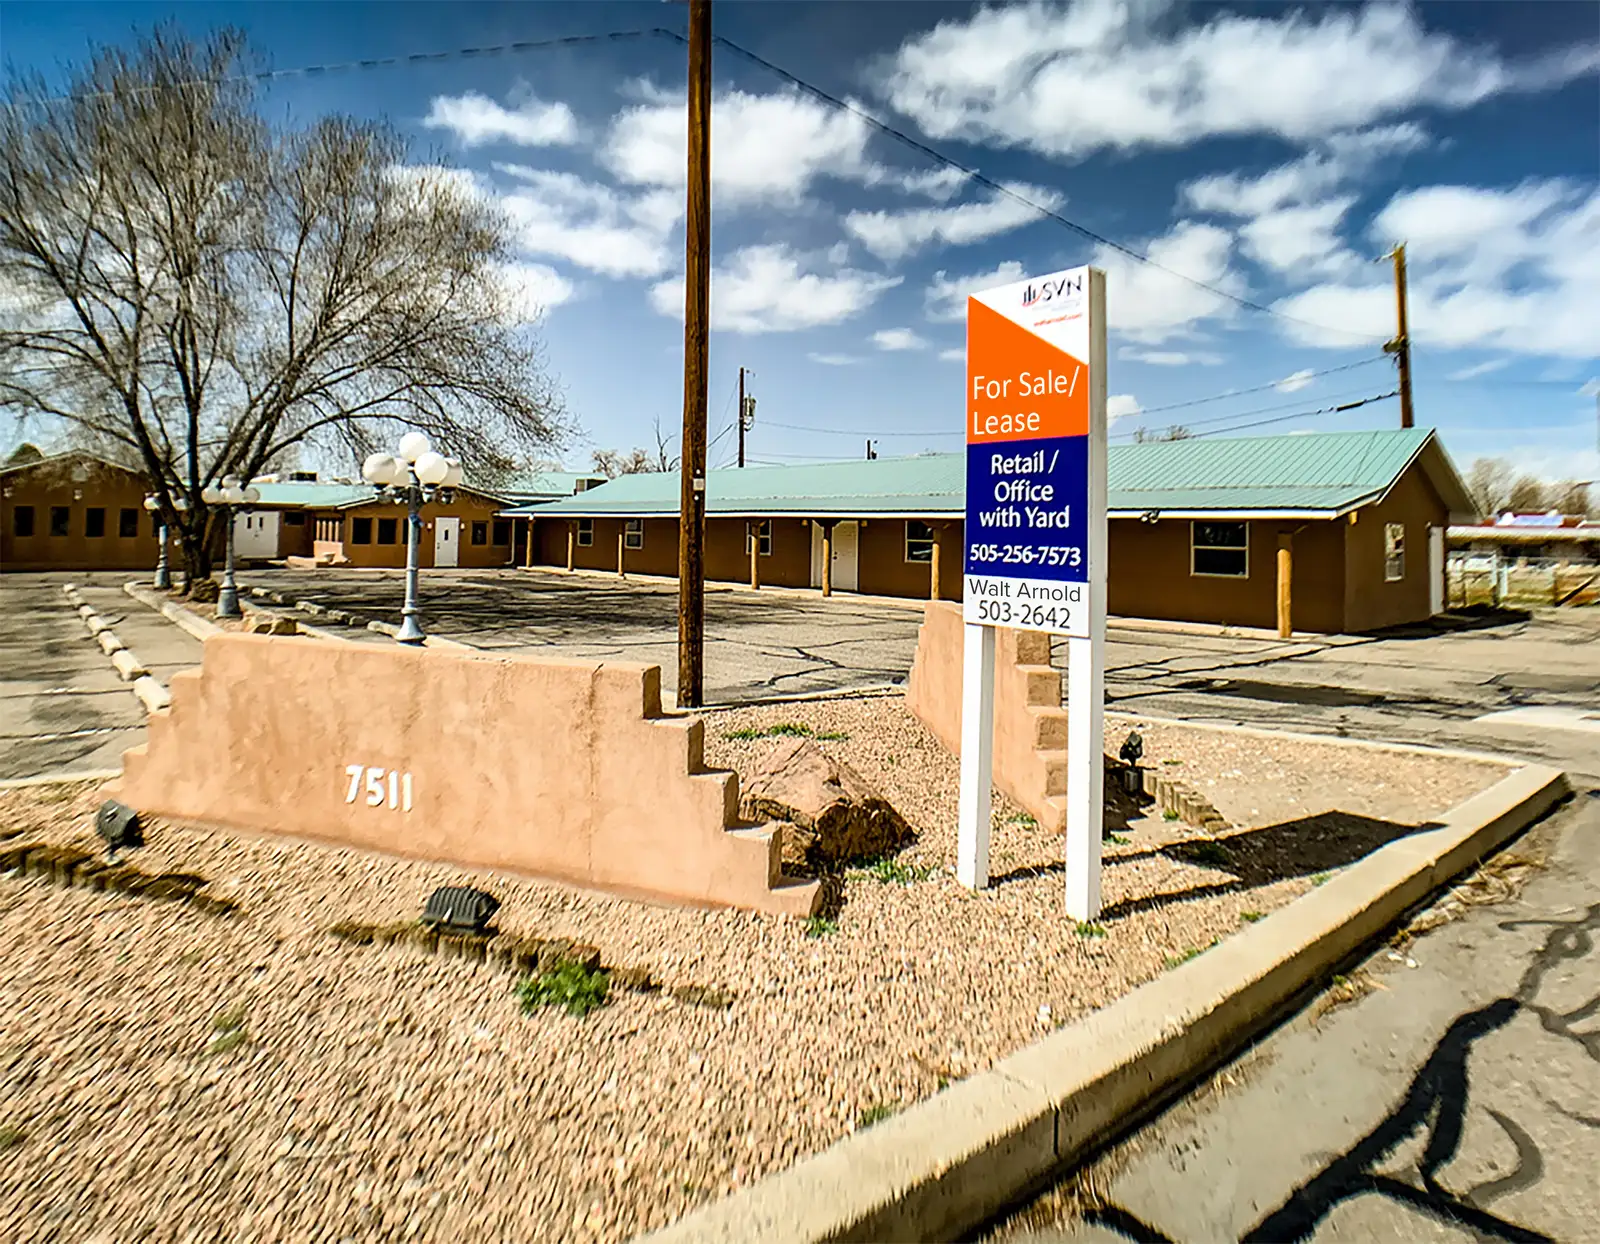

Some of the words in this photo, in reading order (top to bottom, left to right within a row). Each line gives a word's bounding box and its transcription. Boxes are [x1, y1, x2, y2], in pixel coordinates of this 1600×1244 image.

[1042, 275, 1082, 301] SVN
[973, 375, 1012, 400] For
[1019, 365, 1080, 397] Sale/
[973, 411, 1041, 435] Lease
[991, 449, 1044, 475] Retail
[994, 479, 1054, 502] Office
[979, 506, 1021, 528] with
[1025, 505, 1070, 529] Yard
[969, 543, 1082, 567] 505-256-7573
[969, 578, 1011, 598] Walt
[1016, 582, 1081, 602] Arnold
[978, 600, 1071, 629] 503-2642
[344, 764, 412, 813] 7511
